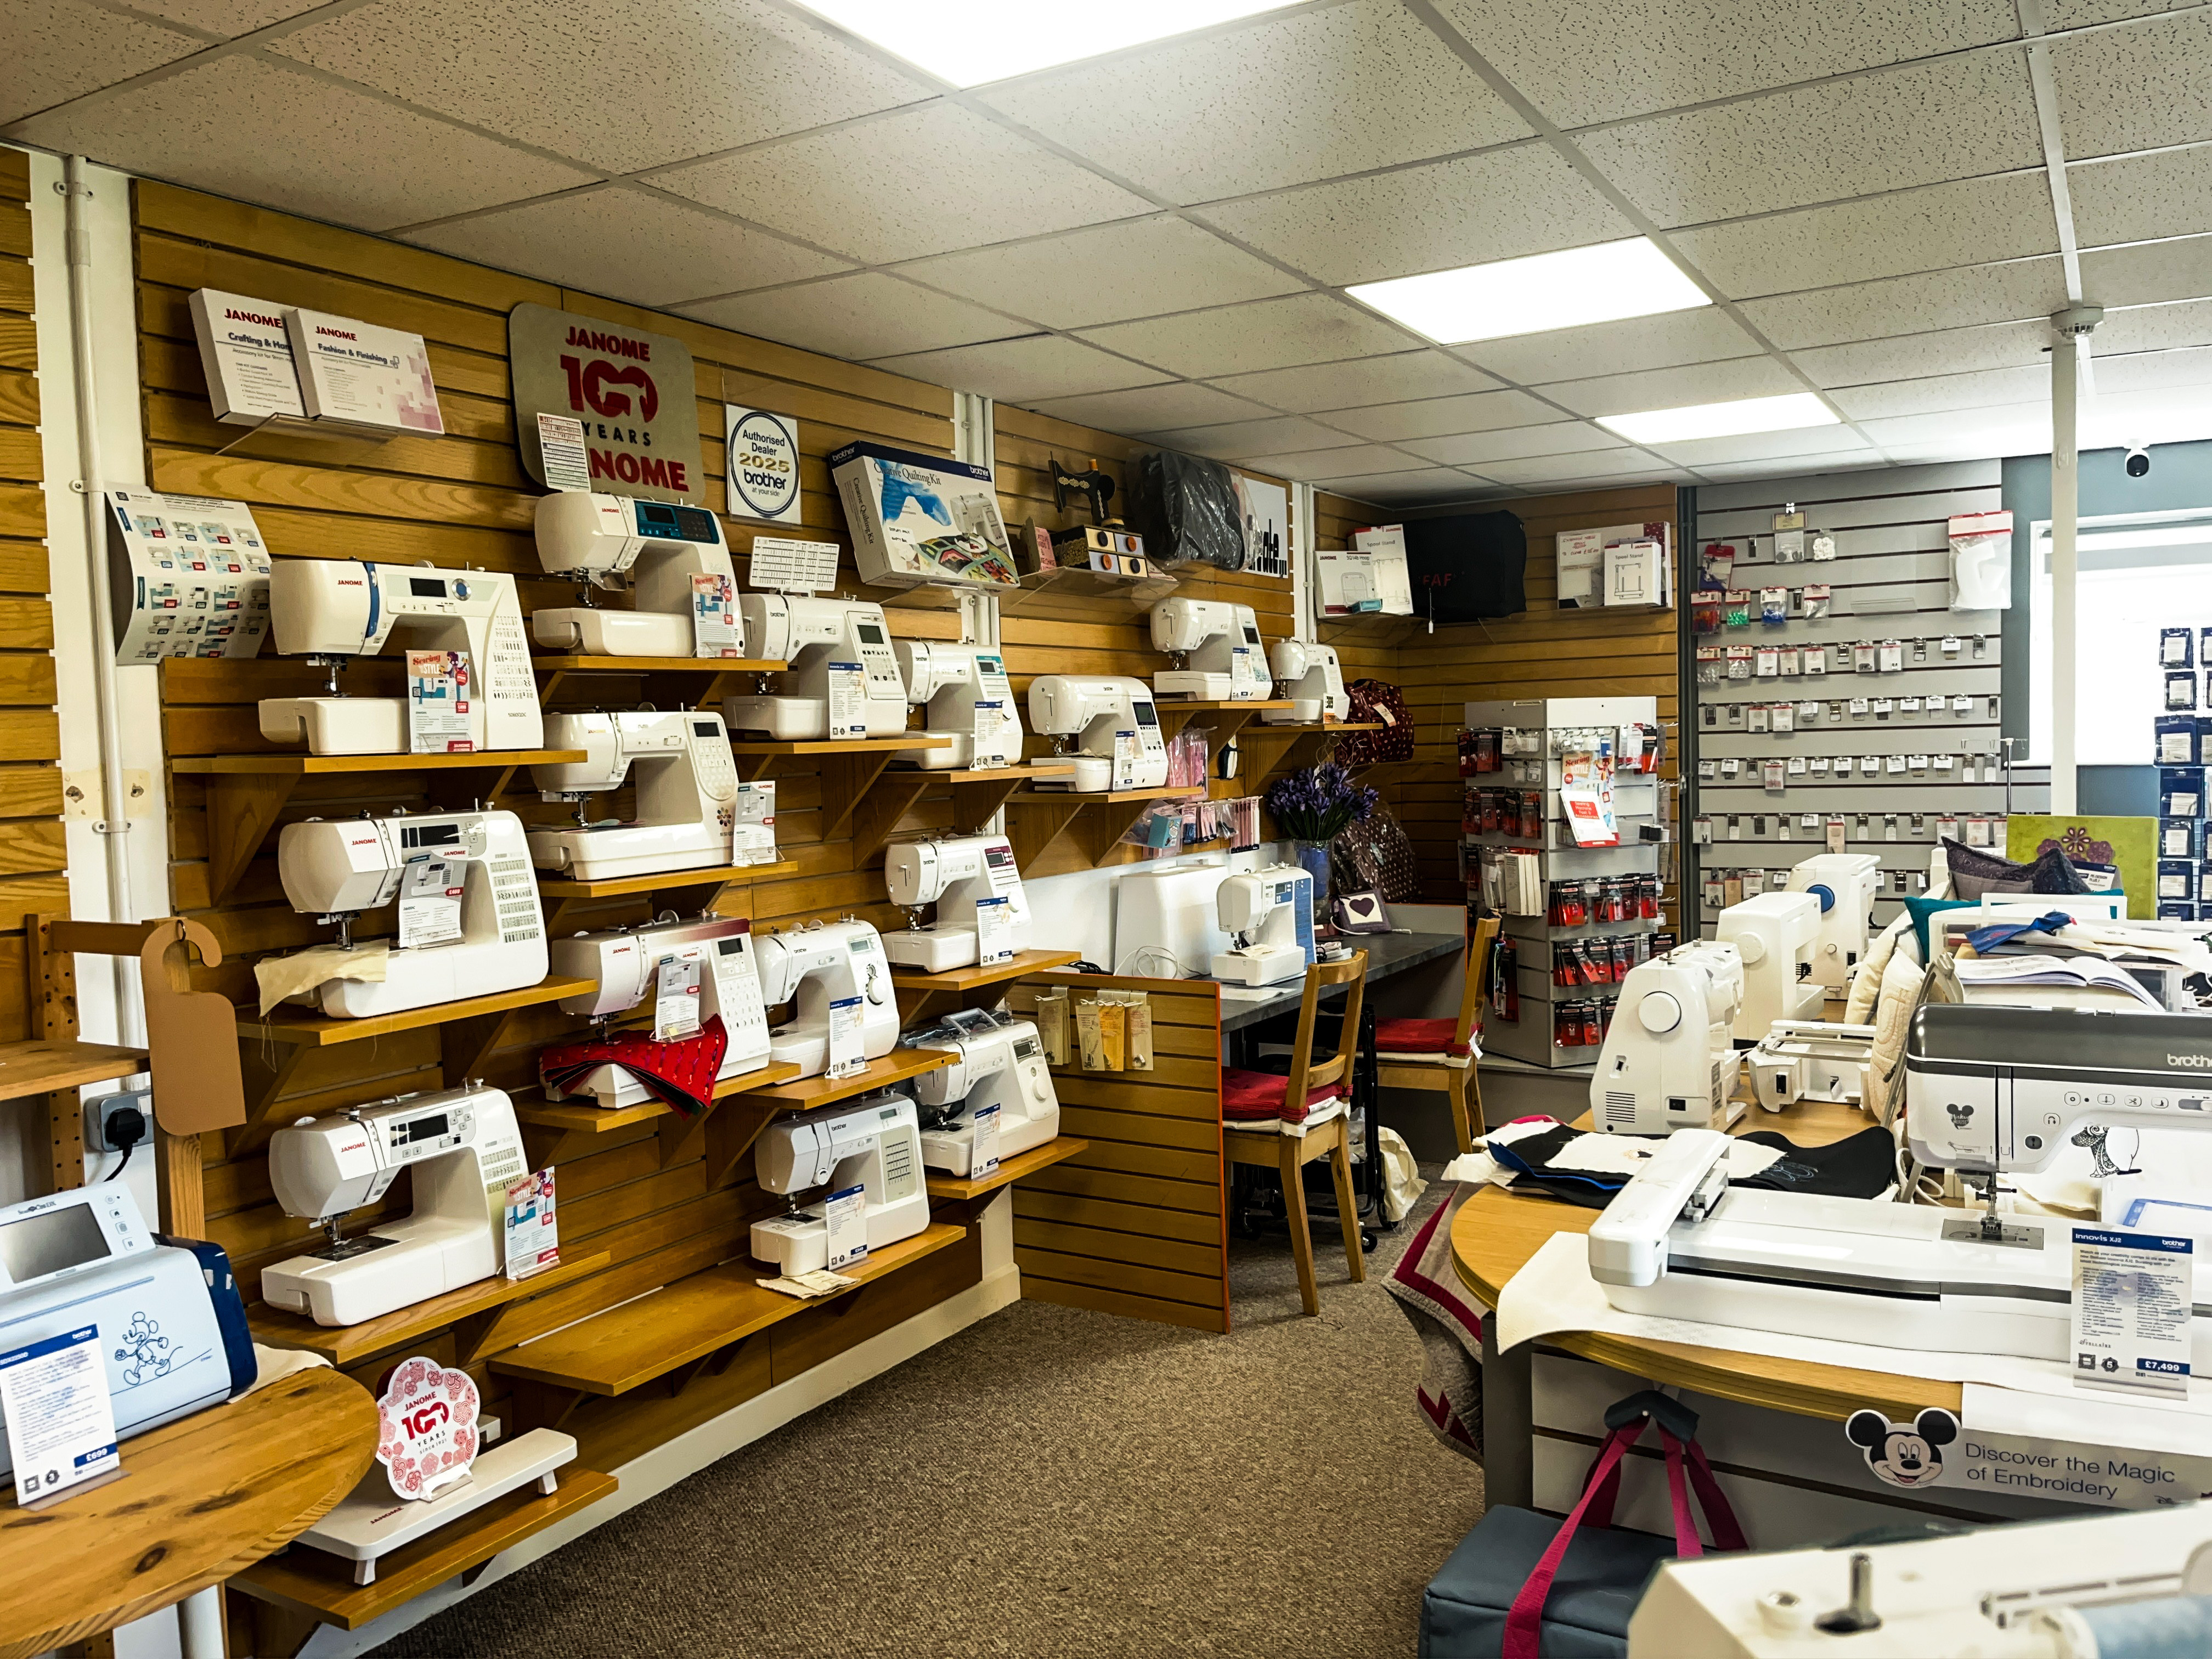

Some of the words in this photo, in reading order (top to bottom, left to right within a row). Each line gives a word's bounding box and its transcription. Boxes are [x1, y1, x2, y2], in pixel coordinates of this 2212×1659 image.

[224, 308, 283, 329] JANOME
[228, 332, 263, 347] Crafting
[264, 338, 272, 347] &
[315, 326, 358, 341] JANOME
[565, 326, 651, 362] JANOME
[318, 343, 346, 356] Fashion
[356, 351, 388, 364] Finishing
[560, 354, 658, 423] 100
[581, 421, 651, 446] YEARS
[743, 429, 785, 447] Authorised
[752, 442, 777, 456] Dealer
[832, 447, 855, 461] brother
[739, 452, 790, 473] 2025
[969, 466, 989, 476] brother
[743, 469, 786, 490] brother
[874, 463, 901, 477] Creative
[902, 469, 930, 486] Quilting
[929, 473, 941, 486] Kit
[853, 477, 864, 505] Creative
[860, 505, 871, 534] Quilting
[413, 654, 441, 665] Sewing
[424, 664, 441, 674] STYLE
[1566, 756, 1590, 766] Sewing
[1575, 765, 1588, 774] STYLE
[341, 1142, 366, 1152] JANOME
[509, 1178, 532, 1197] Sewing
[517, 1187, 531, 1201] STYLE
[2162, 1239, 2186, 1247] brother
[2145, 1361, 2180, 1372] £7,499
[405, 1391, 437, 1411] JANOME
[401, 1402, 449, 1440] 100
[417, 1430, 445, 1447] YEARS
[86, 1448, 108, 1462] £699
[1966, 1442, 2058, 1468] Discover
[2066, 1457, 2100, 1474] the
[2108, 1460, 2175, 1483] Magic
[1967, 1467, 1987, 1481] of
[1994, 1468, 2118, 1500] Embroidery
[370, 1506, 403, 1524] JANOME
